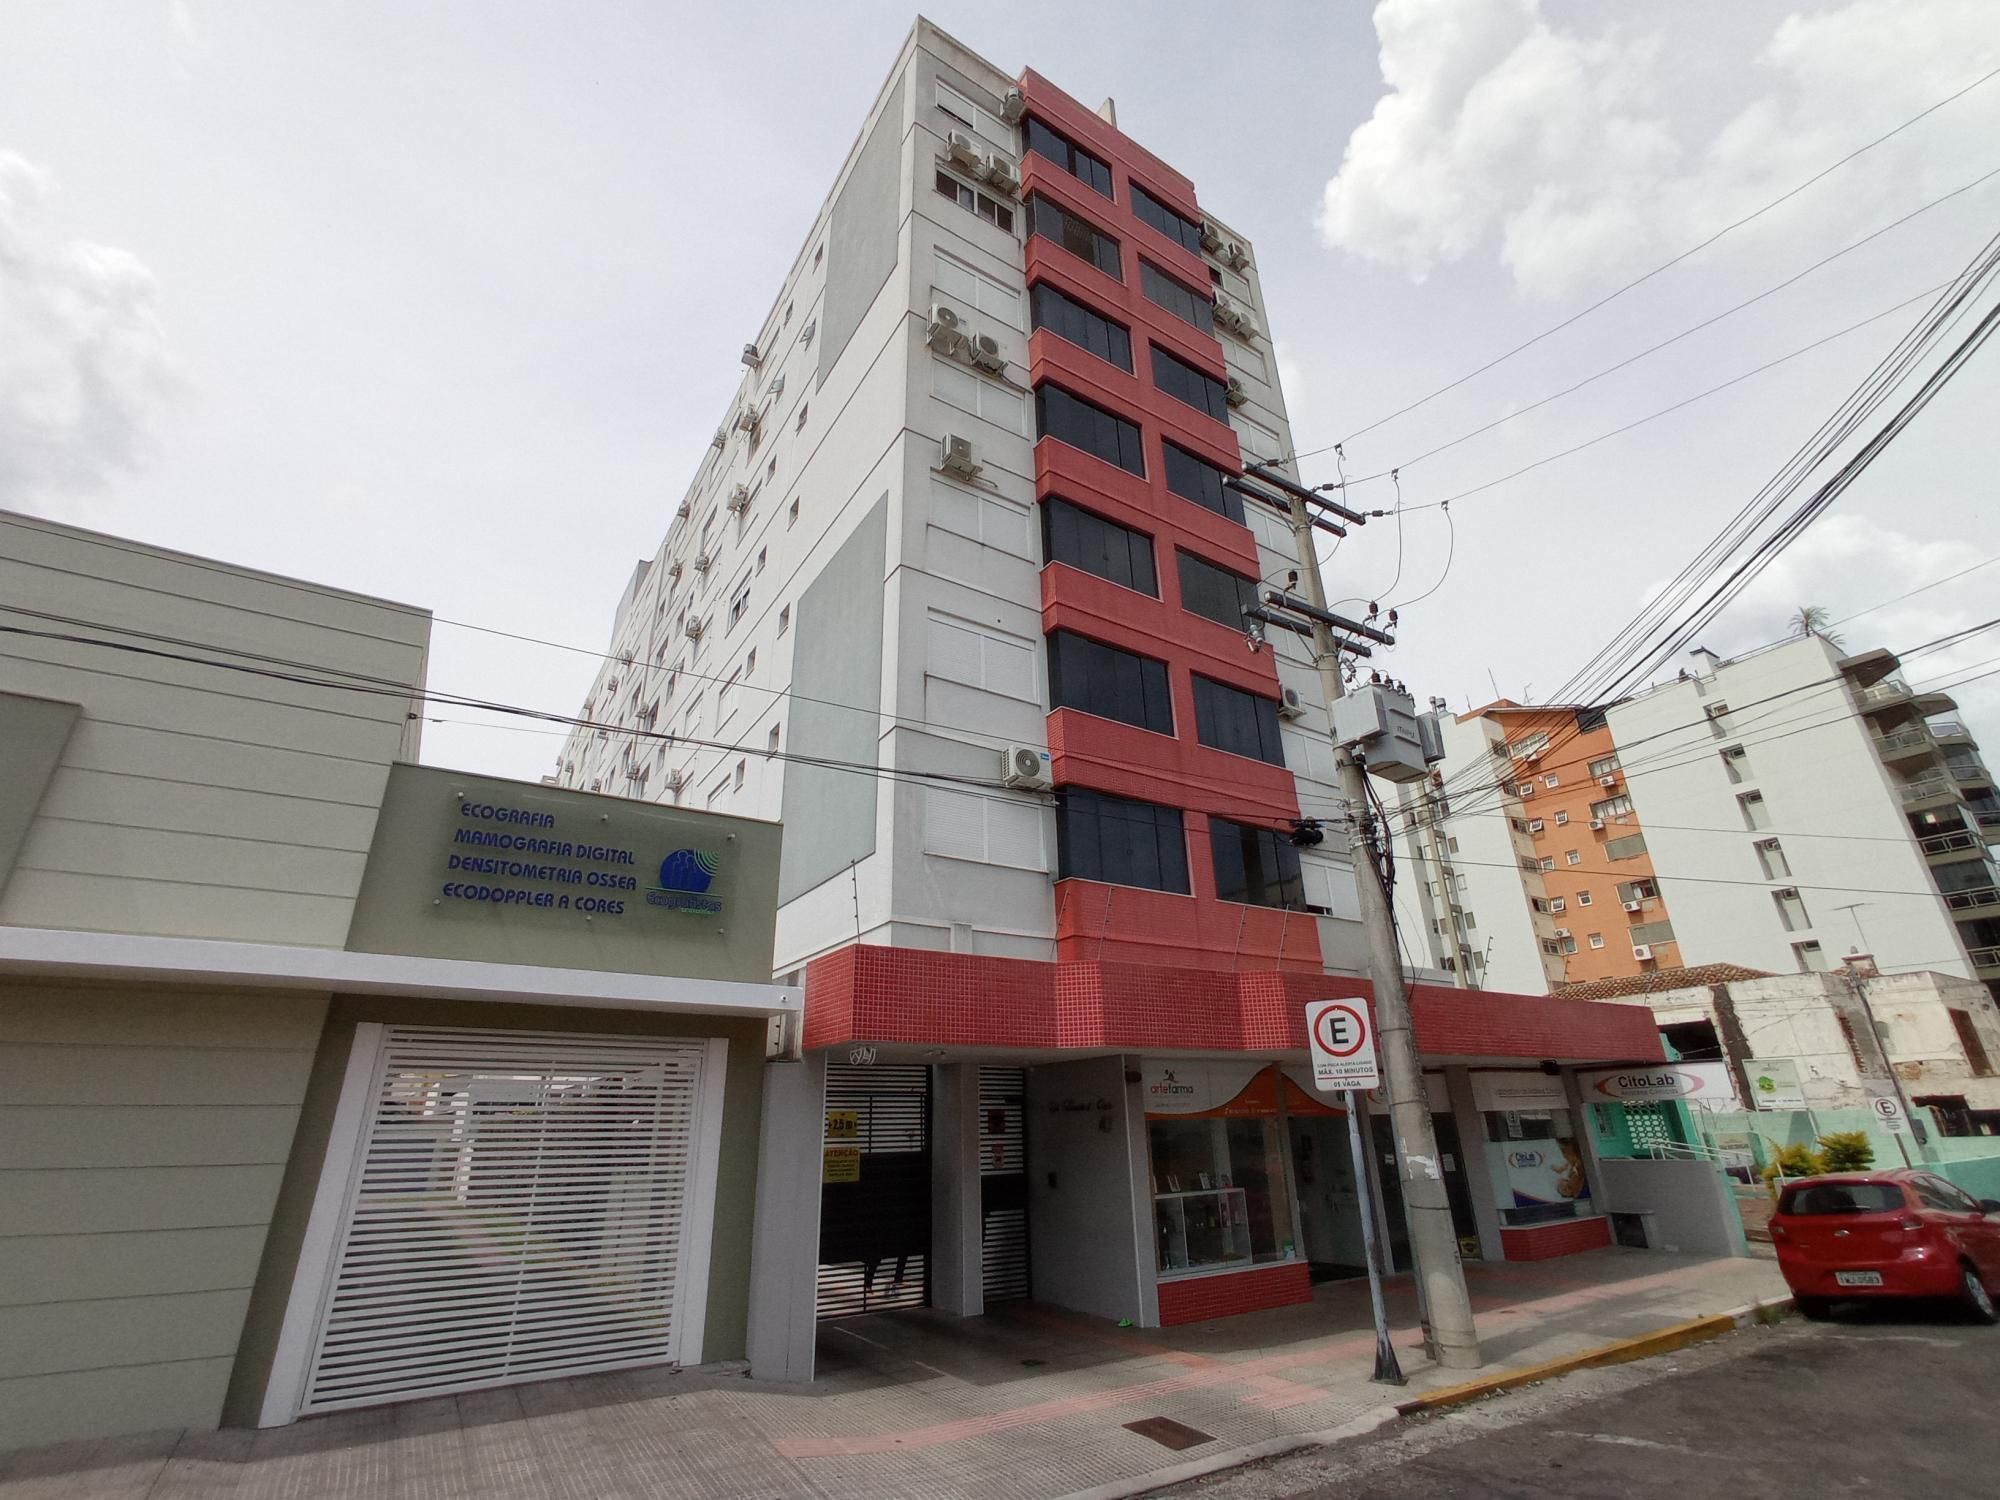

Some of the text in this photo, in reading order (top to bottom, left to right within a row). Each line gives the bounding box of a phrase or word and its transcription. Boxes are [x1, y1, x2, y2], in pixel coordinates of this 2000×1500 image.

[461, 803, 555, 828] ECOGRAFIA
[454, 828, 635, 865] MAMOGRAFIA DIGITAL
[448, 855, 637, 891] DENSITOMETRIA OSSEA
[443, 883, 625, 914] ECODOPPLER A CORES
[1329, 1017, 1349, 1044] E
[1344, 1066, 1374, 1074] MINUTOS
[1618, 1074, 1675, 1087] CitoLab
[1880, 1102, 1892, 1113] E
